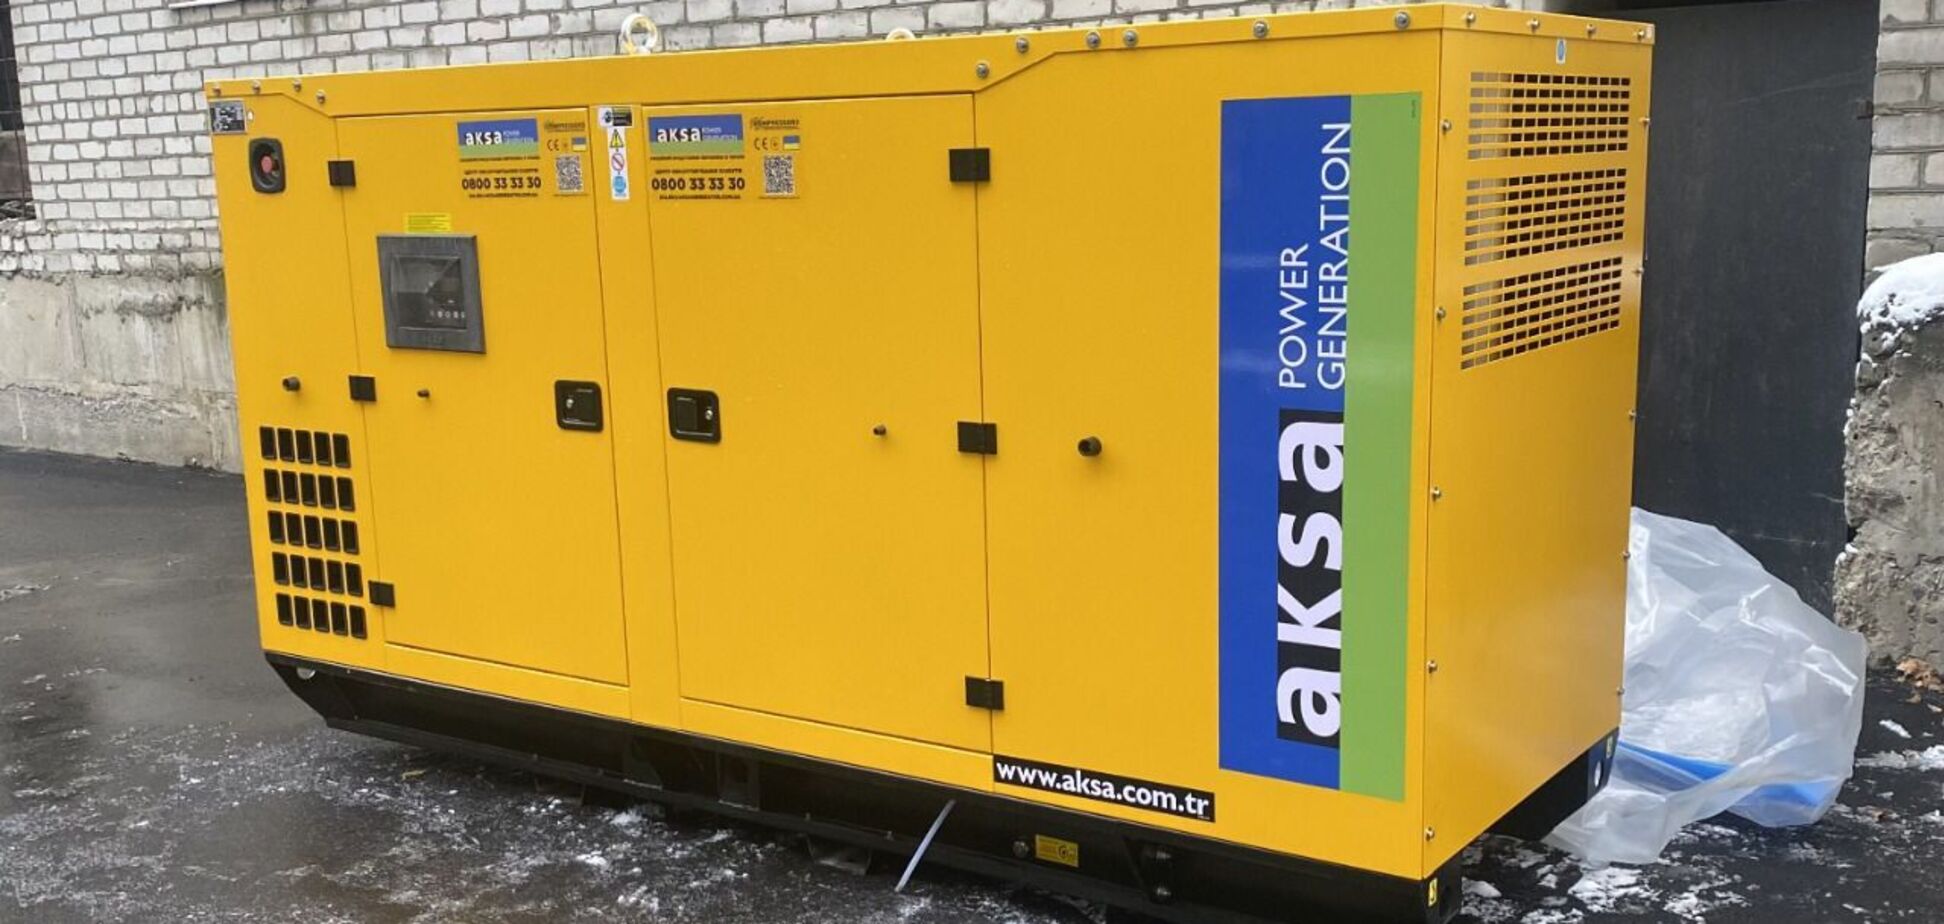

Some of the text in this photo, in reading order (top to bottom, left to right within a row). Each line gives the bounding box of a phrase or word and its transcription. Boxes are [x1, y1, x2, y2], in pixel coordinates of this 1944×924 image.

[465, 130, 503, 145] aksa
[657, 127, 701, 143] aksa
[462, 176, 542, 190] 0800 33 33 30
[651, 177, 746, 191] 0800 33 33 30
[1317, 122, 1351, 390] GENERATION
[1279, 243, 1309, 389] POWER
[1276, 421, 1345, 738] aksa
[996, 762, 1209, 816] www.aksa.com.tr
